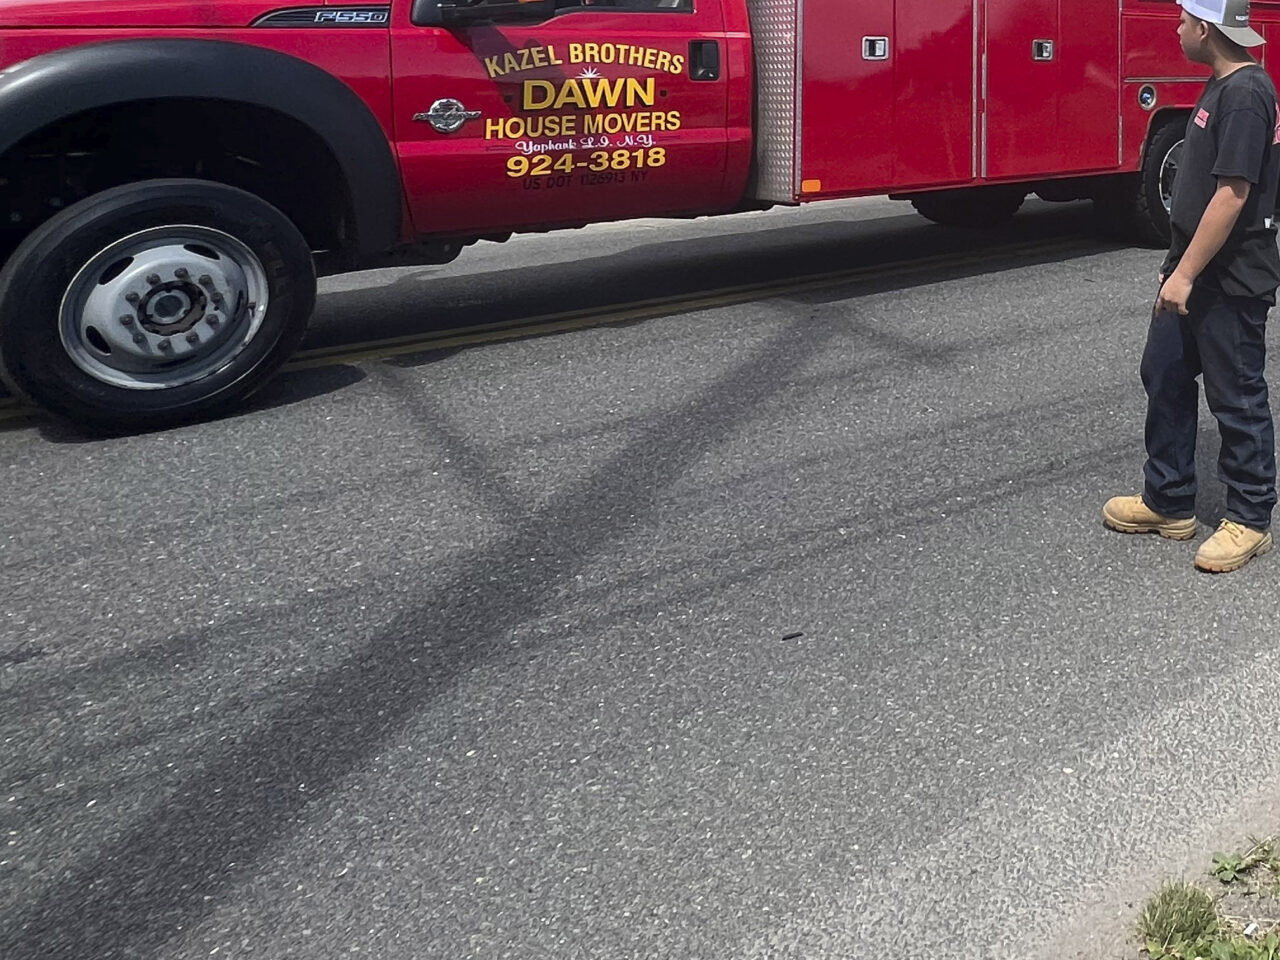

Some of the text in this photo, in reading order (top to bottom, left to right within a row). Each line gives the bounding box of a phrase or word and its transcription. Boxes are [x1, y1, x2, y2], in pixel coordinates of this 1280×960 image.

[484, 43, 684, 78] KAZEL BROTHERS
[523, 77, 655, 110] DAWN
[485, 111, 681, 139] HOUSE MOVERS
[515, 139, 577, 155] Yaphank
[617, 134, 657, 148] N.Y.
[506, 147, 666, 177] 924-3818
[523, 178, 541, 190] US
[546, 175, 572, 188] DOT
[631, 171, 648, 182] NY
